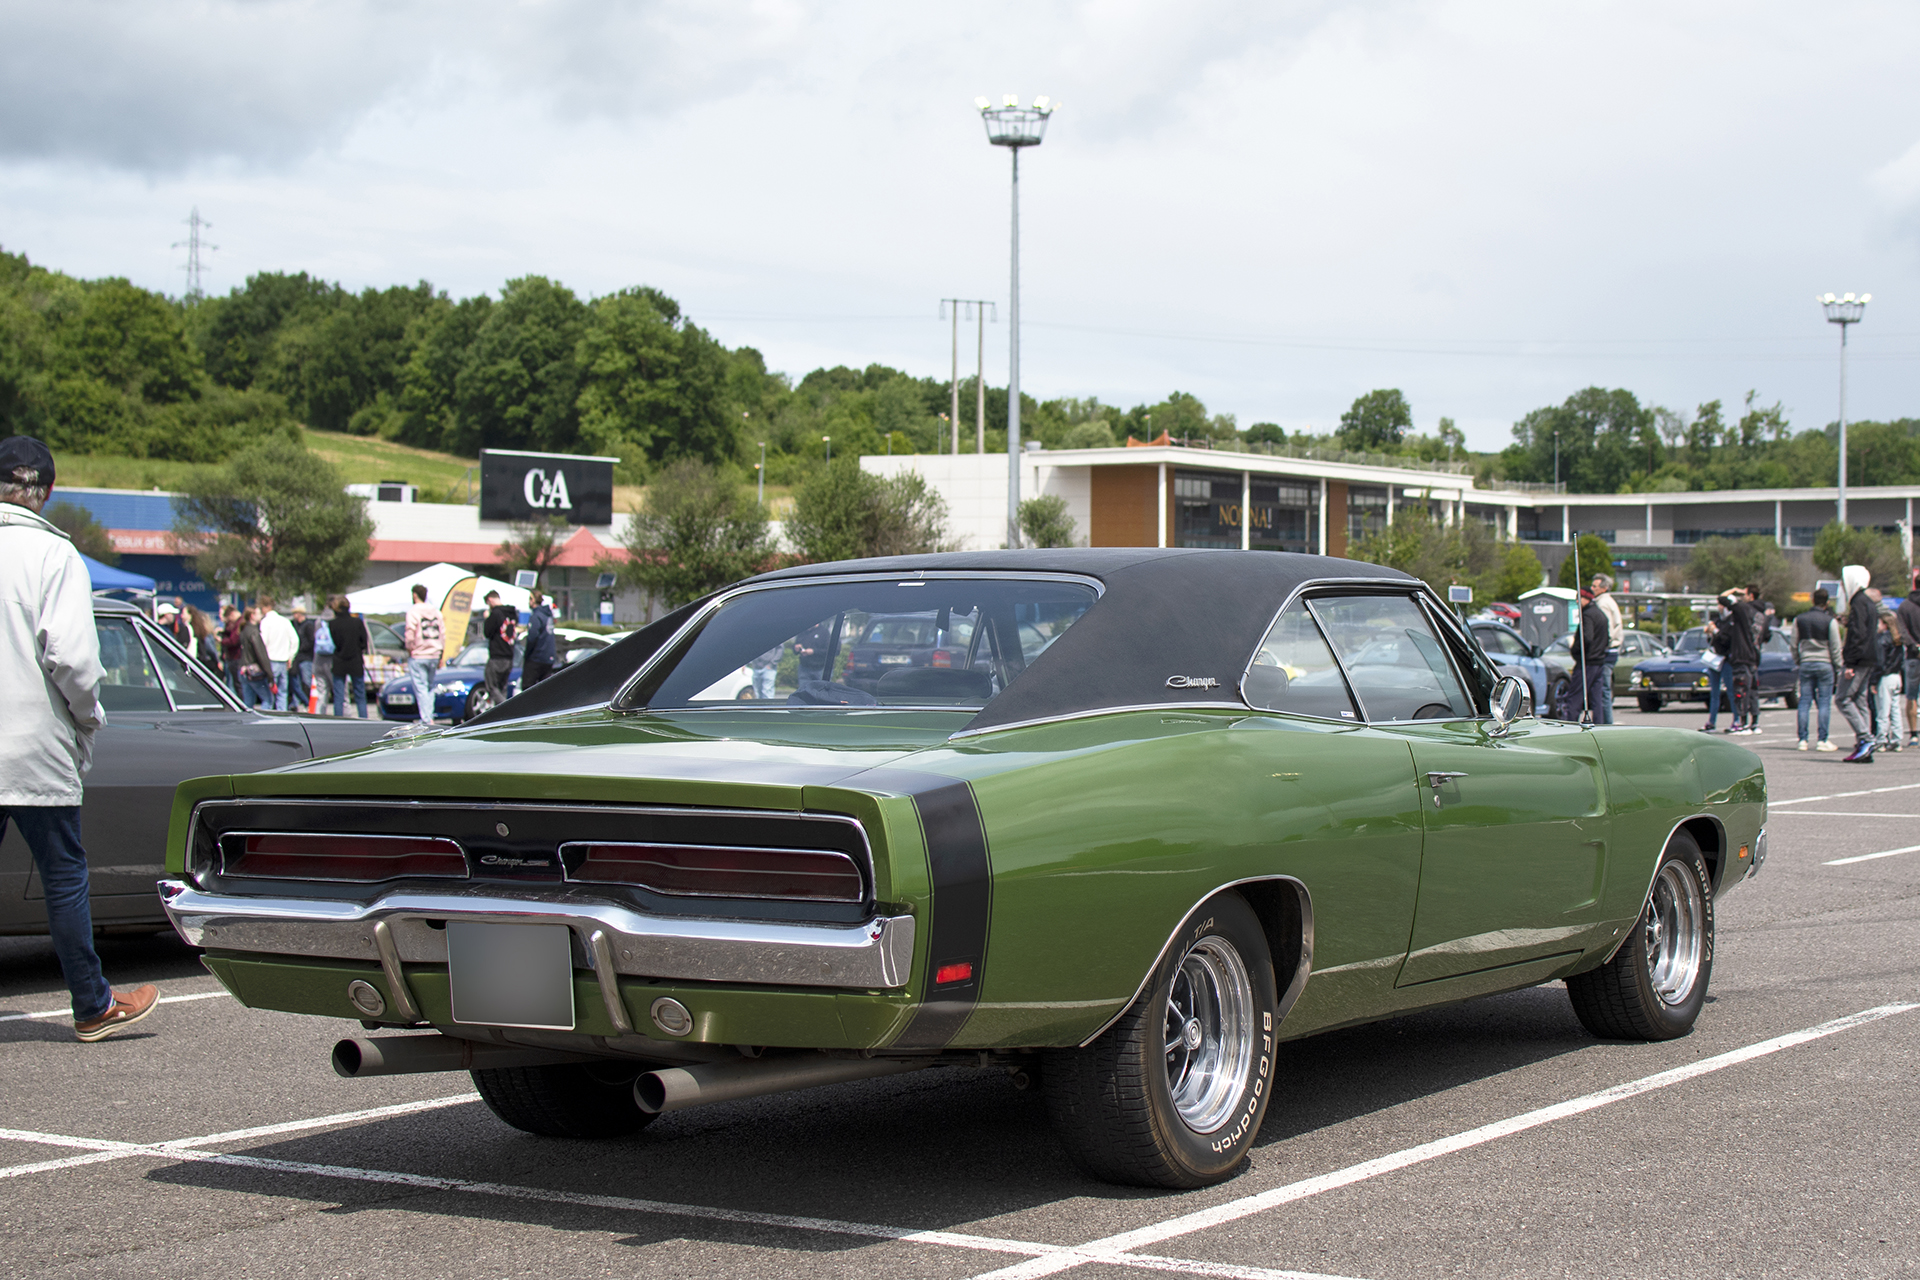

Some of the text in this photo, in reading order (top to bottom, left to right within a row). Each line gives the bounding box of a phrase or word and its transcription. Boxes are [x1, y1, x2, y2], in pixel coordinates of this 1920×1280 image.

[524, 467, 573, 509] C&A
[1193, 917, 1214, 938] T/A
[1211, 1011, 1272, 1153] BFGoodrich
